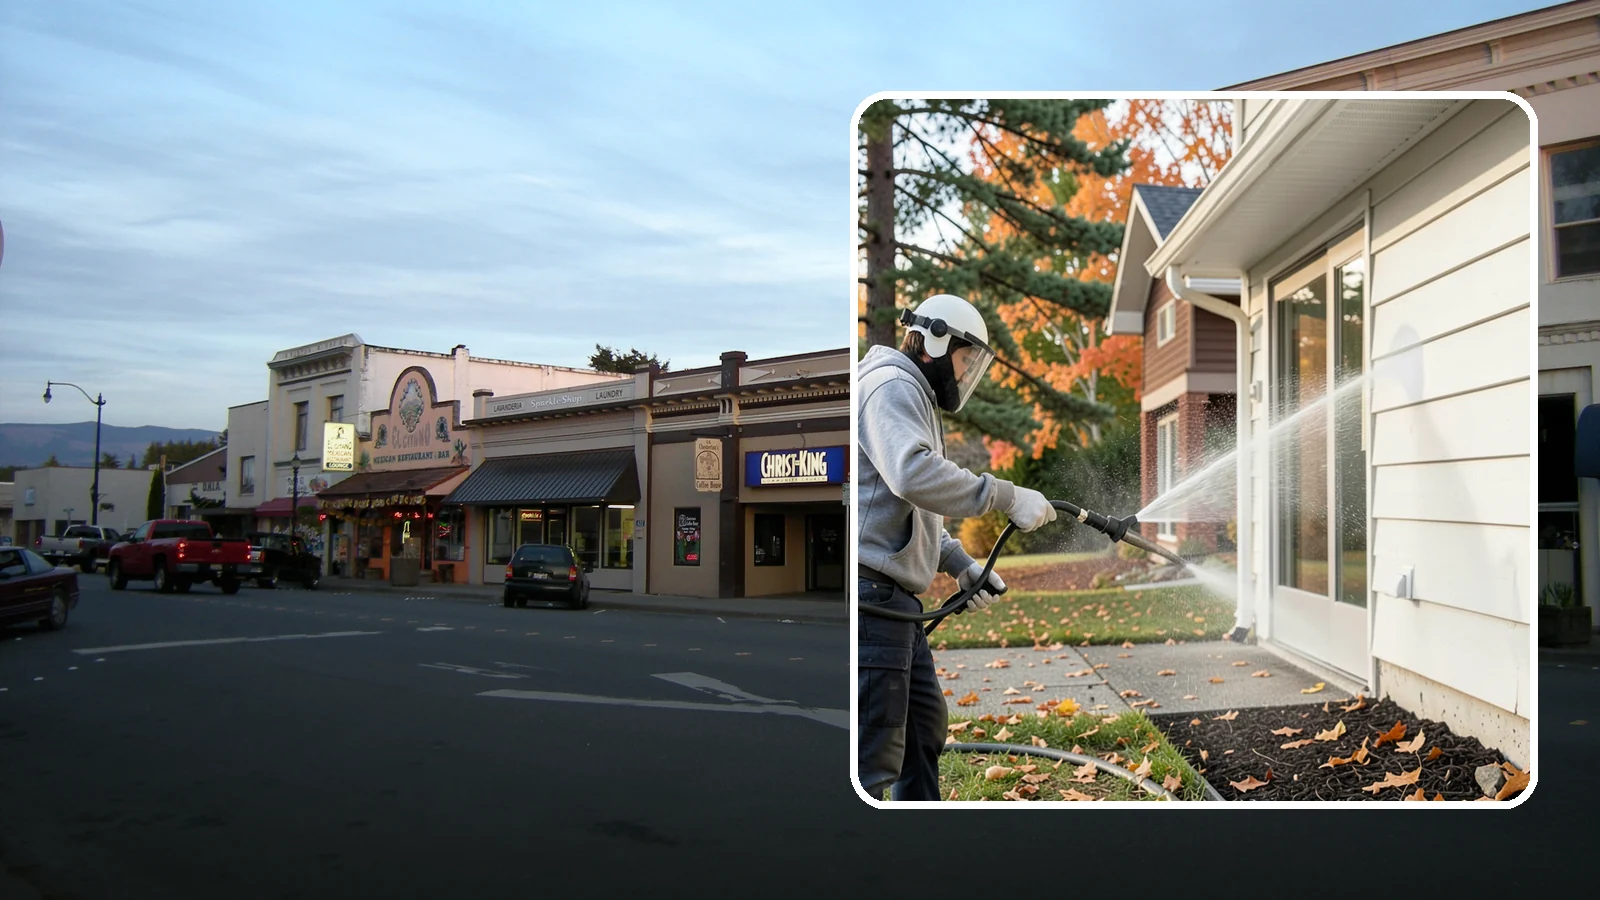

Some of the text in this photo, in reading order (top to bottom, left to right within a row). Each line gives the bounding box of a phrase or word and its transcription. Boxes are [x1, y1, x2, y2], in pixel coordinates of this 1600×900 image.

[493, 402, 522, 412] LAVANDERIA
[561, 394, 582, 403] Shop
[595, 388, 623, 400] LAUNDRY
[398, 451, 433, 462] RESTAURANT
[438, 450, 450, 459] BAR
[760, 450, 827, 478] CHRIST KING
